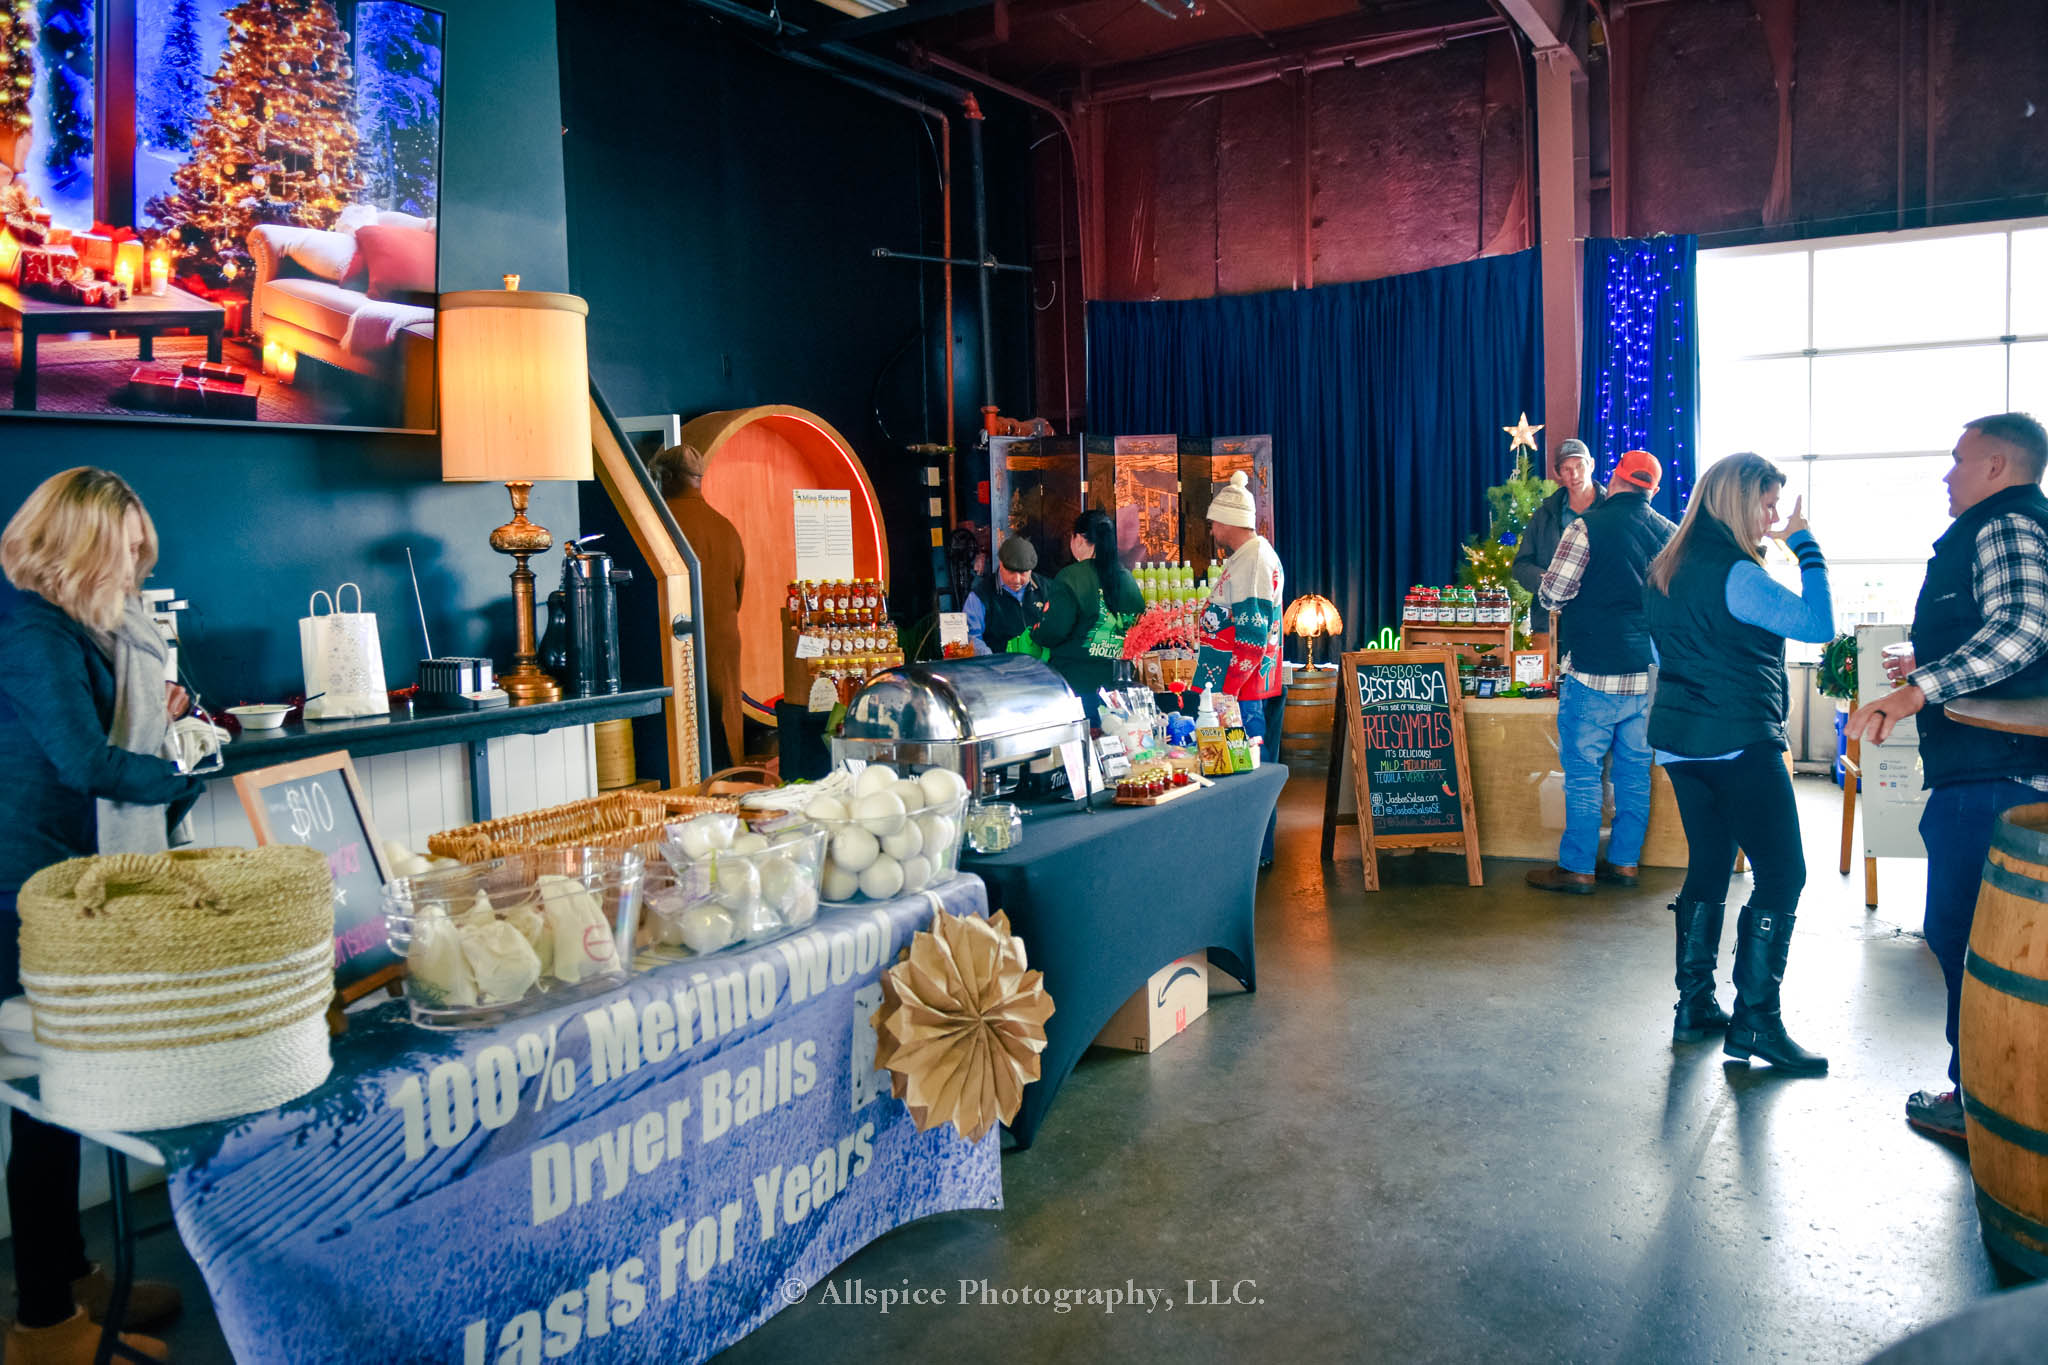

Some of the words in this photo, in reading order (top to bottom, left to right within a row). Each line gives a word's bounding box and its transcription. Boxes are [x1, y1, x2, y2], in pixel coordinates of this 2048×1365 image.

[1357, 671, 1394, 705] BEST
[1395, 670, 1448, 704] SALSA
[1372, 664, 1423, 679] JASBO'S
[1390, 704, 1400, 712] SIDE
[1407, 703, 1416, 711] THE
[1416, 704, 1432, 712] BORDER
[1361, 713, 1390, 750] FREE
[1389, 711, 1453, 749] SAMPLES
[1380, 759, 1400, 771] MILD
[1385, 749, 1397, 758] IT'S
[1398, 749, 1432, 759] DELICIOUS!
[285, 781, 334, 842] $10
[390, 1026, 575, 1162] 100%
[584, 960, 777, 1087] Merino
[776, 908, 892, 1003] Wool
[530, 1097, 691, 1226] Dryer
[702, 1037, 818, 1144] Balls
[659, 1199, 743, 1300] For
[752, 1121, 875, 1242] Years
